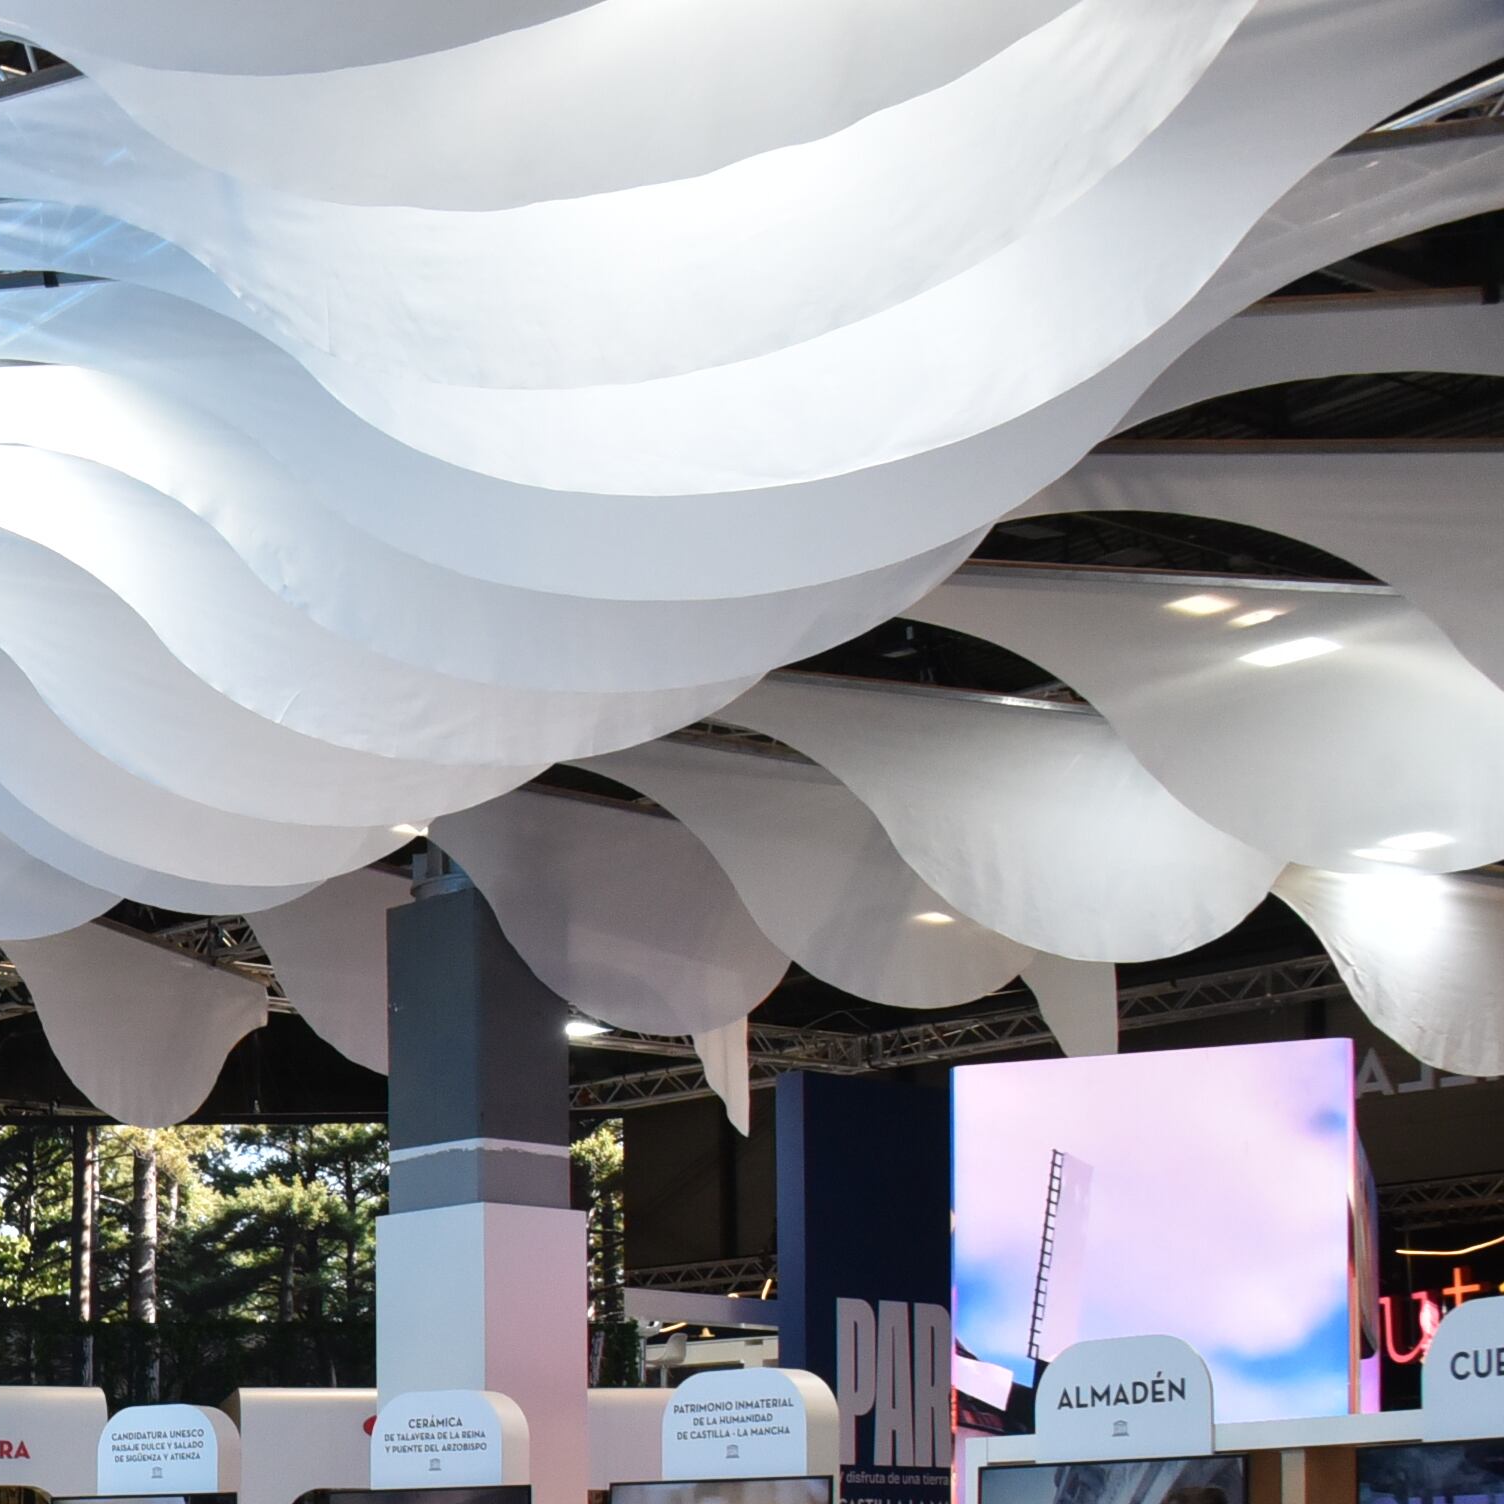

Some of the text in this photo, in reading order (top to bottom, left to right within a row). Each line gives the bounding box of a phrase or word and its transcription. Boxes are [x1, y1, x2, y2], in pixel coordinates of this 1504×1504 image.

[1057, 1370, 1186, 1411] ALMADÉN
[673, 1397, 795, 1414] PATRIMONIO INMATERIAL
[408, 1414, 463, 1429] CERÁMICA
[692, 1413, 774, 1427] DE LA HUMANIDAD
[111, 1428, 205, 1441] CANDIDATURA UNESCO
[384, 1430, 486, 1442] DE TALAVERA DE LA REINA
[676, 1431, 688, 1441] DE
[689, 1429, 731, 1440] CASTILLA
[737, 1428, 749, 1438] LA
[750, 1426, 791, 1437] MANCHA
[111, 1440, 204, 1452] PAISAJE DULCE Y SALADO
[384, 1442, 488, 1454] Y PUENTE DEL ARZOBISPO
[114, 1452, 201, 1463] DE SIGÜENZA Y ATIENZA
[846, 1471, 886, 1484] disfruta
[887, 1472, 901, 1484] de
[902, 1476, 921, 1485] una
[922, 1473, 950, 1486] tierra
